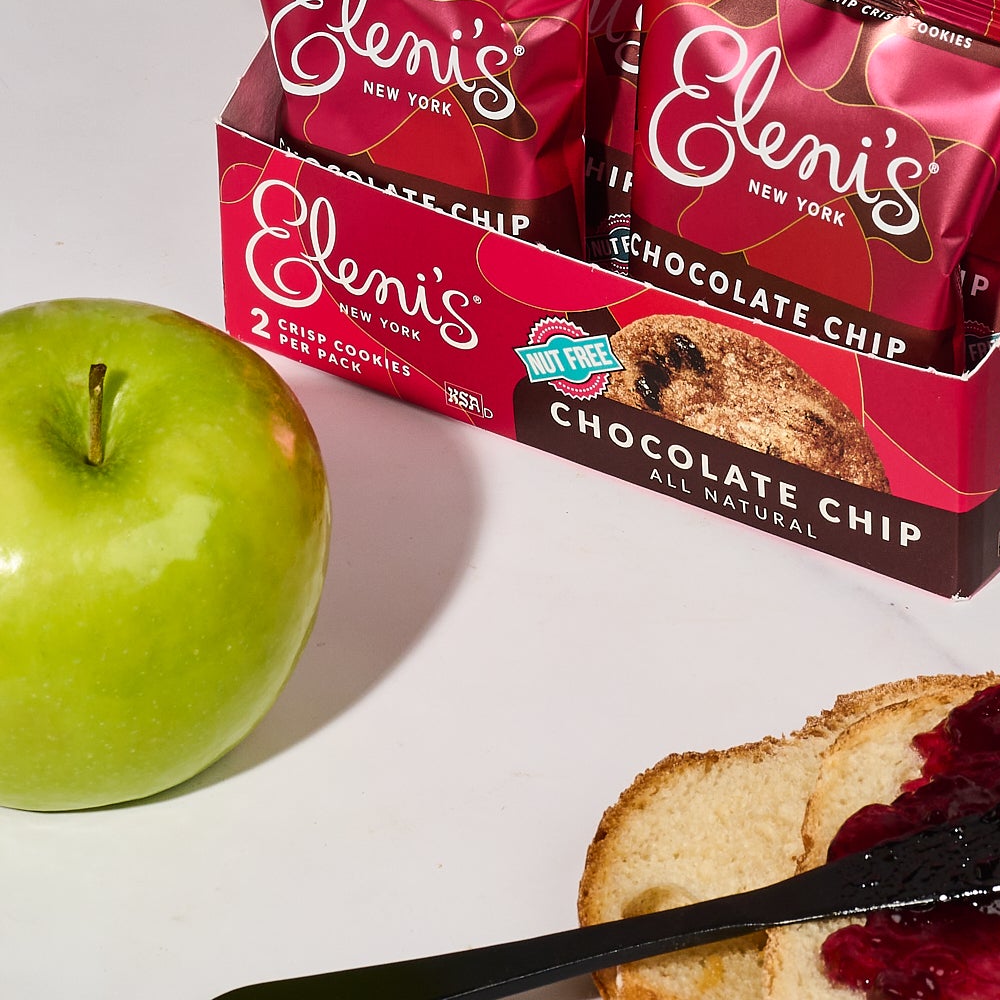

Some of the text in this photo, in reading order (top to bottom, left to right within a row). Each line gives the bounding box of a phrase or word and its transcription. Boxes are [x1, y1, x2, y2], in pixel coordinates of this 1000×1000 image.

[861, 5, 897, 20] CRIS
[911, 21, 973, 50] OOKIES
[363, 80, 452, 117] NEW YORK
[451, 202, 530, 236] CHIP
[748, 178, 846, 227] NEW YORK
[630, 232, 907, 359] CHOCOLATE CHIP
[250, 308, 412, 377] 2 CRISP COOKIES
[340, 302, 421, 342] NEW YORK
[280, 332, 362, 374] PER PACK
[525, 341, 613, 376] NUT FREE
[549, 400, 922, 548] CHOCOLATE CHIP
[650, 468, 818, 540] ALL NATURAL
